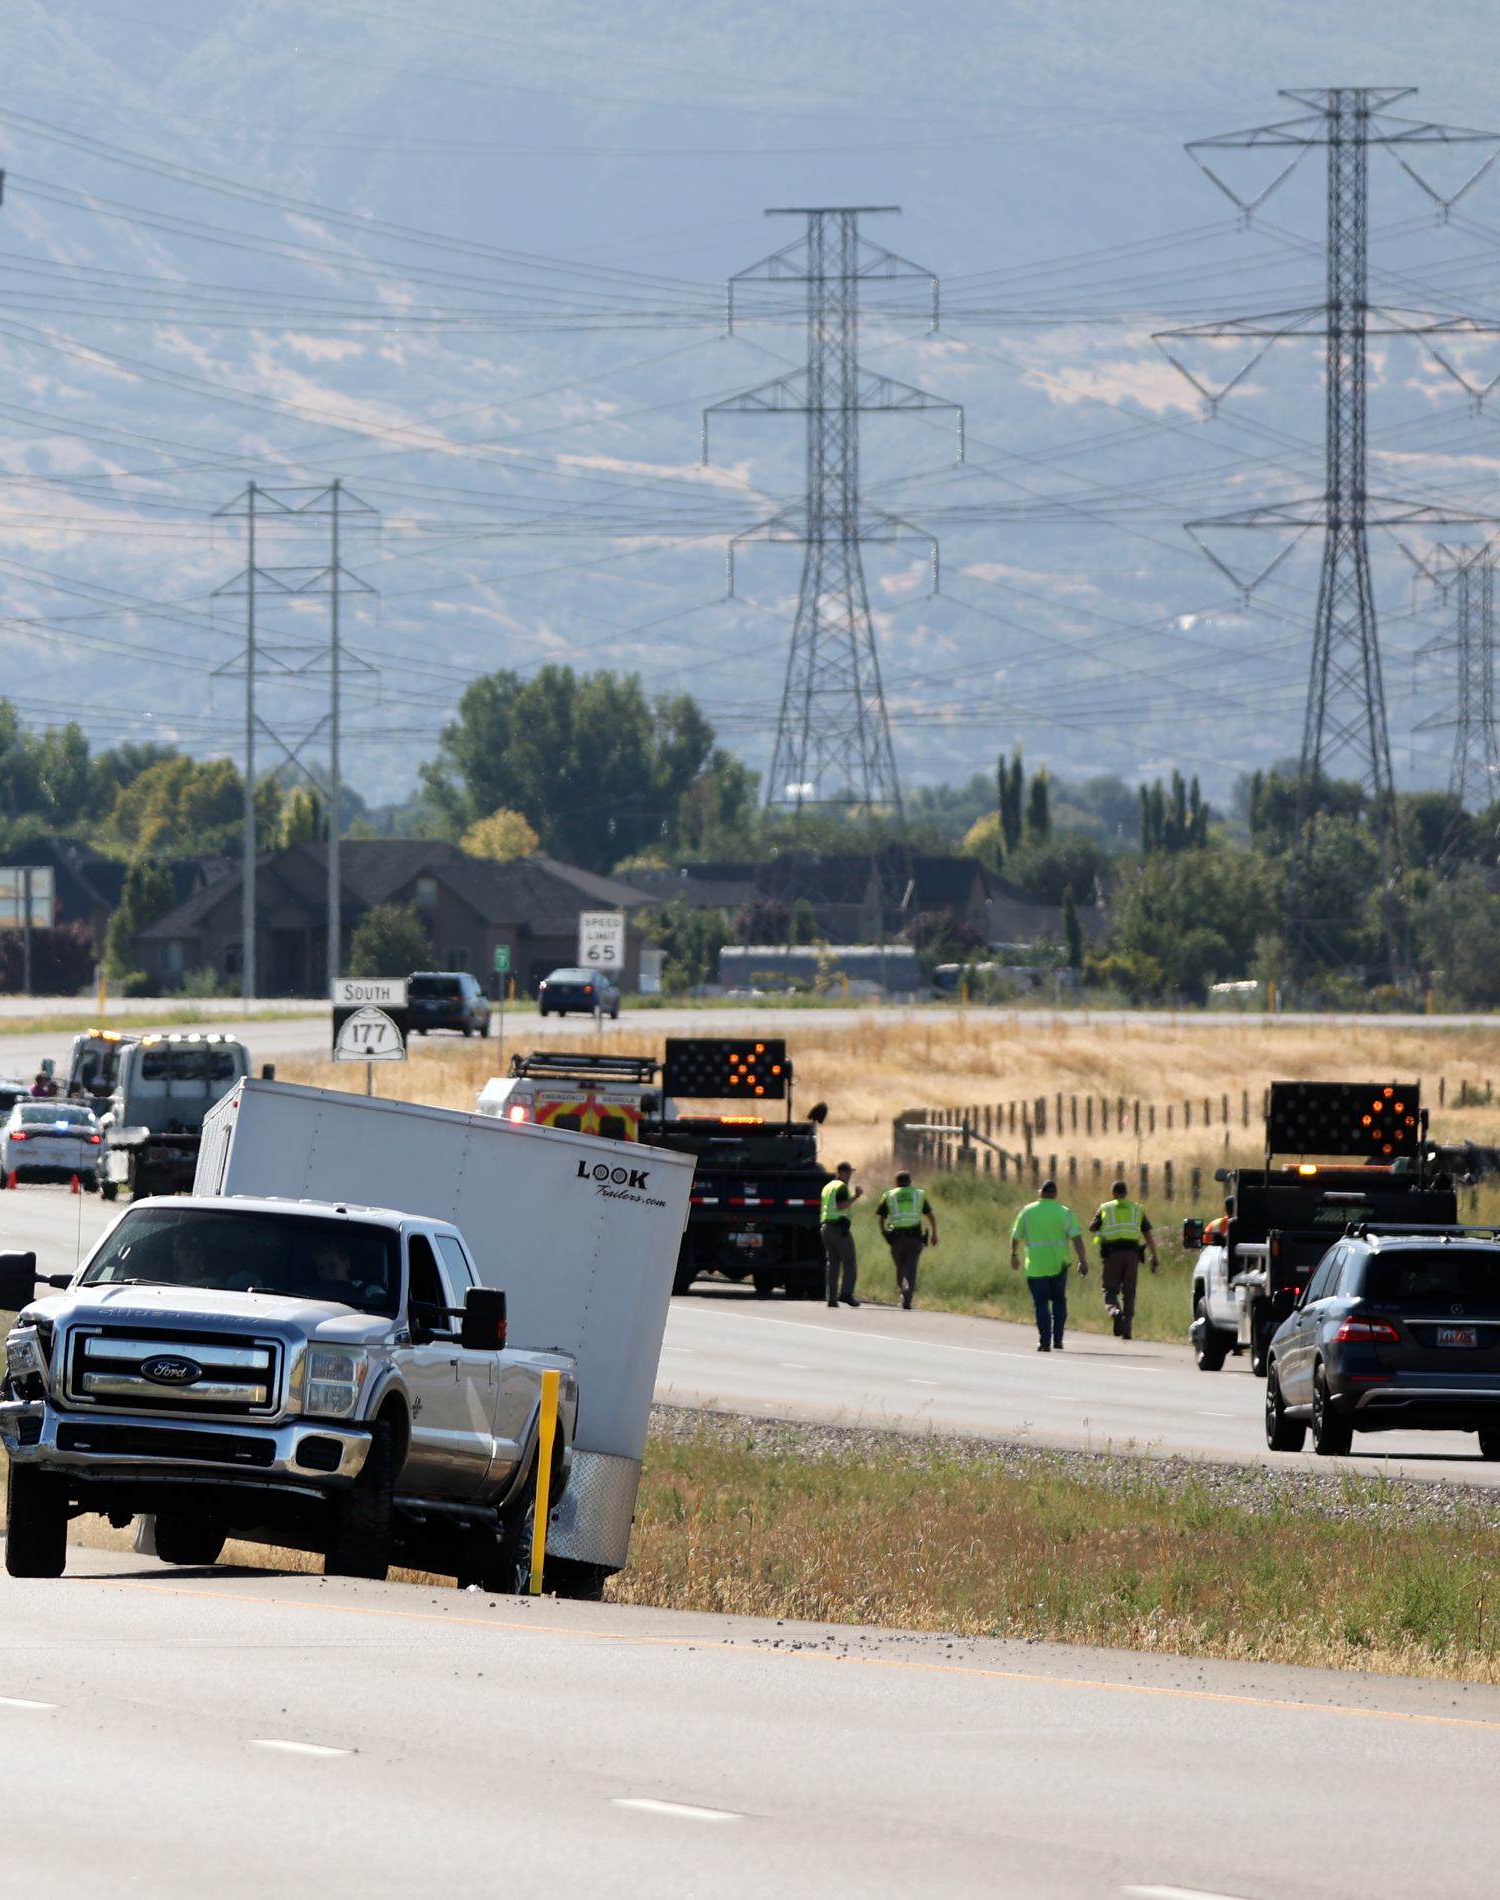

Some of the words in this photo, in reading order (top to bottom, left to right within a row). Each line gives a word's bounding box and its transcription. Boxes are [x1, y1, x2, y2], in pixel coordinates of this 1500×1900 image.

[584, 917, 620, 927] SPEED
[587, 931, 616, 940] LIMIT
[587, 944, 615, 960] 65
[344, 983, 390, 1000] SOUTH
[352, 1023, 387, 1043] 177
[602, 1096, 635, 1104] VEHICLE
[576, 1160, 650, 1189] LOOK
[595, 1184, 667, 1207] Trailers.com
[153, 1361, 188, 1378] Ford
